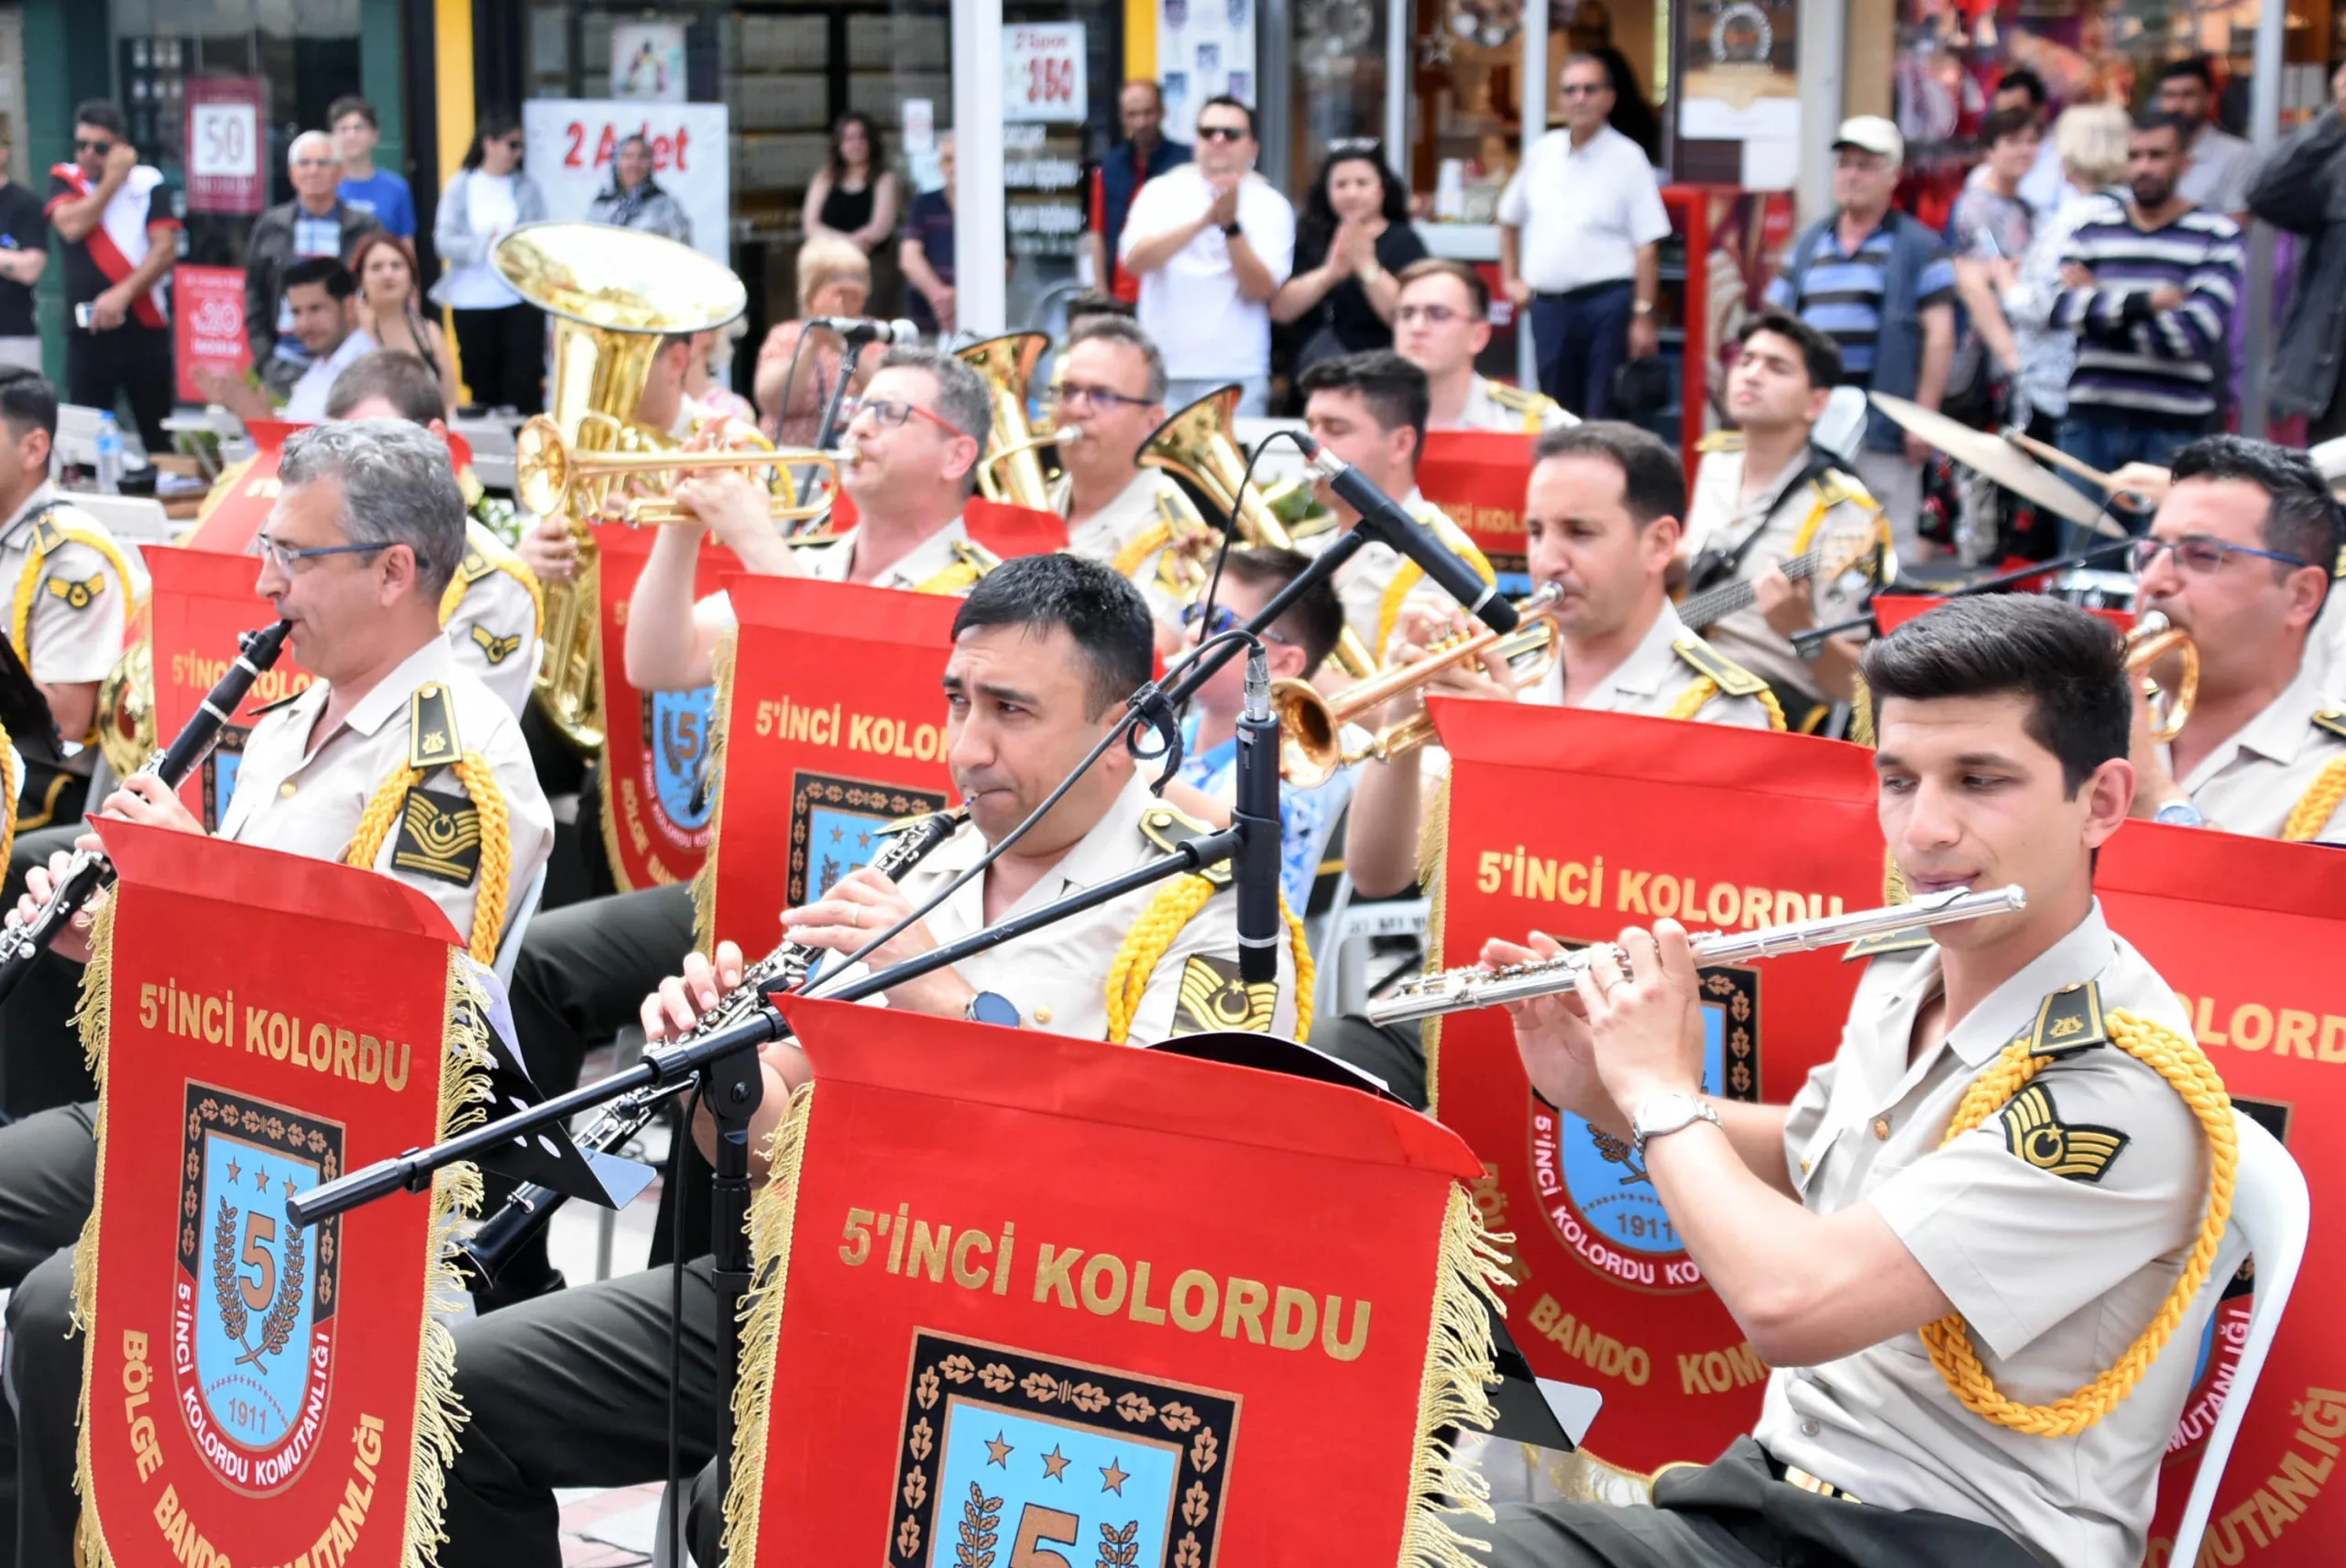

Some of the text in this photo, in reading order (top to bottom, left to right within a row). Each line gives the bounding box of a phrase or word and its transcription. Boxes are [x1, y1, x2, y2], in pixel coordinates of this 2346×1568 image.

[207, 115, 246, 165] 50
[565, 120, 691, 171] 2 Aet
[171, 648, 235, 688] 5'İNC
[677, 711, 697, 759] 5
[755, 695, 841, 748] 5'İNCİ
[1477, 845, 1604, 908] 5'İNCİ
[139, 977, 411, 1091] 5'İNCİ KOLORDU
[1533, 1114, 1562, 1197] 5'İNCİ
[1551, 1205, 1654, 1285] KOLORDU
[1617, 1212, 1676, 1243] 1911
[237, 1210, 276, 1311] 5
[839, 1202, 1371, 1362] 5'İNCİ KOLORDU
[1528, 1293, 1650, 1387] BANDO
[123, 1329, 163, 1484] BÖLGE
[176, 1283, 331, 1486] 5'İNCİ KOLORDU KOMUTANLIĞI
[228, 1397, 268, 1436] 1911
